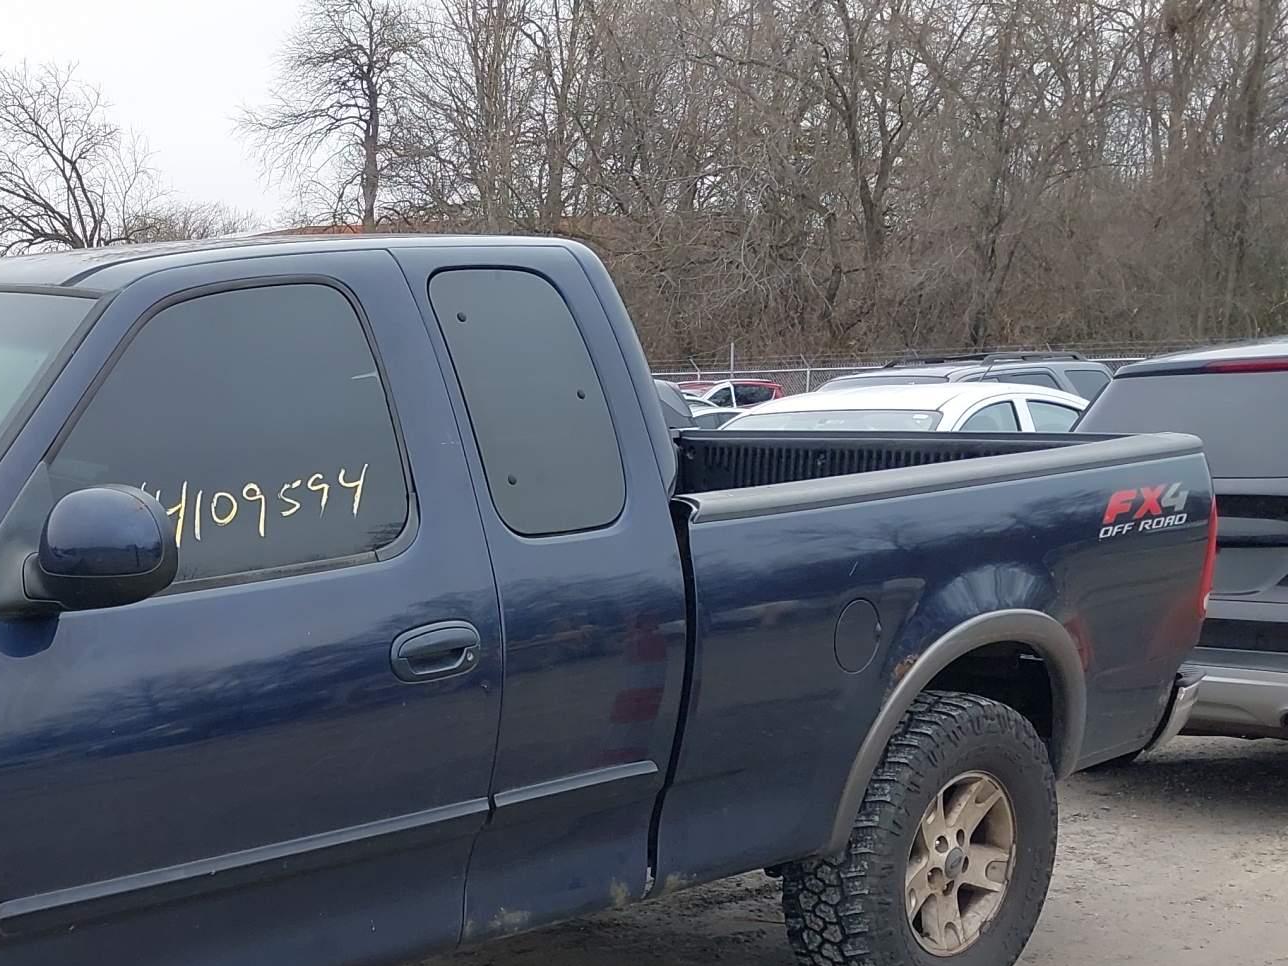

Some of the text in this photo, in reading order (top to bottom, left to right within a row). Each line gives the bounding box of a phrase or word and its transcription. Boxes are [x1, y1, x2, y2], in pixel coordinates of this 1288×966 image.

[141, 463, 369, 549] 4109594
[1102, 482, 1190, 525] FX4
[1099, 513, 1188, 539] OFF ROAD
